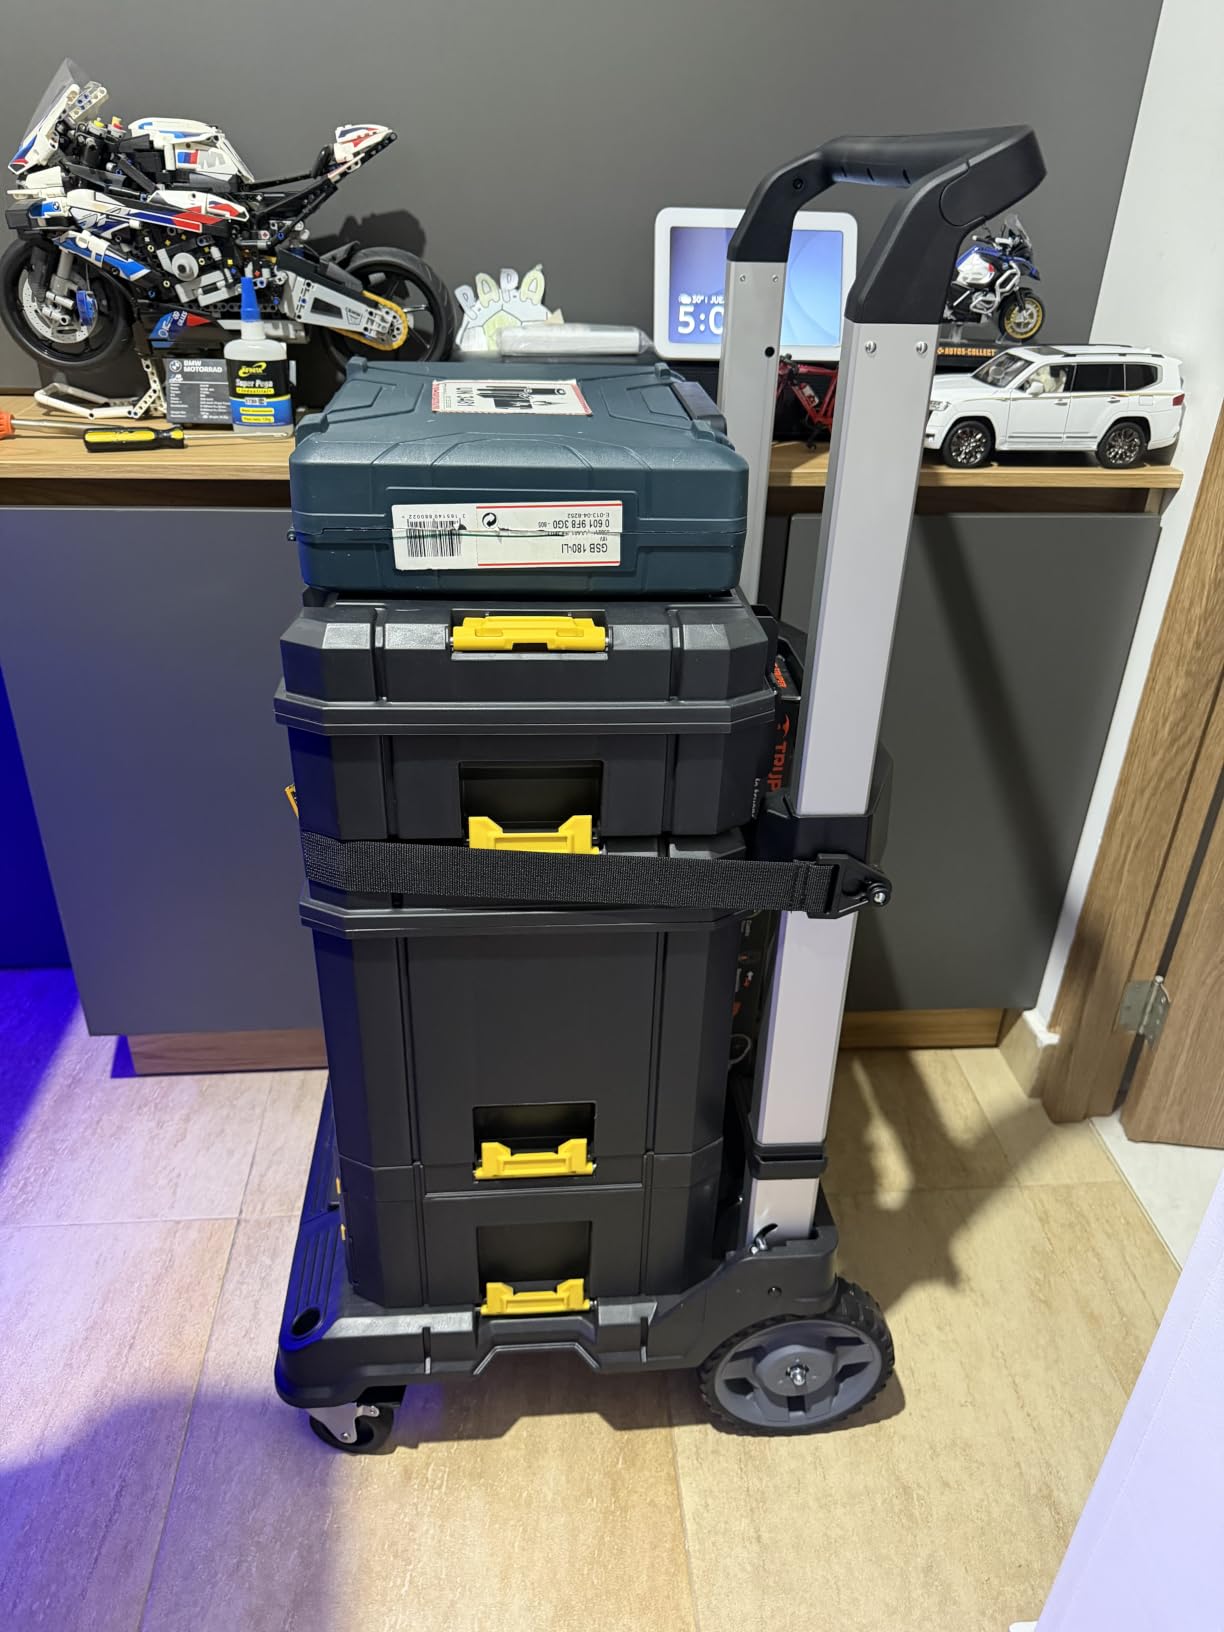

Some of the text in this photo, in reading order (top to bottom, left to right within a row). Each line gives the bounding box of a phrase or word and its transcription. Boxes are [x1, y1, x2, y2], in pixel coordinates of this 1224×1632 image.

[571, 519, 587, 529] 9F8
[588, 519, 603, 529] 601
[589, 542, 608, 553] GSB
